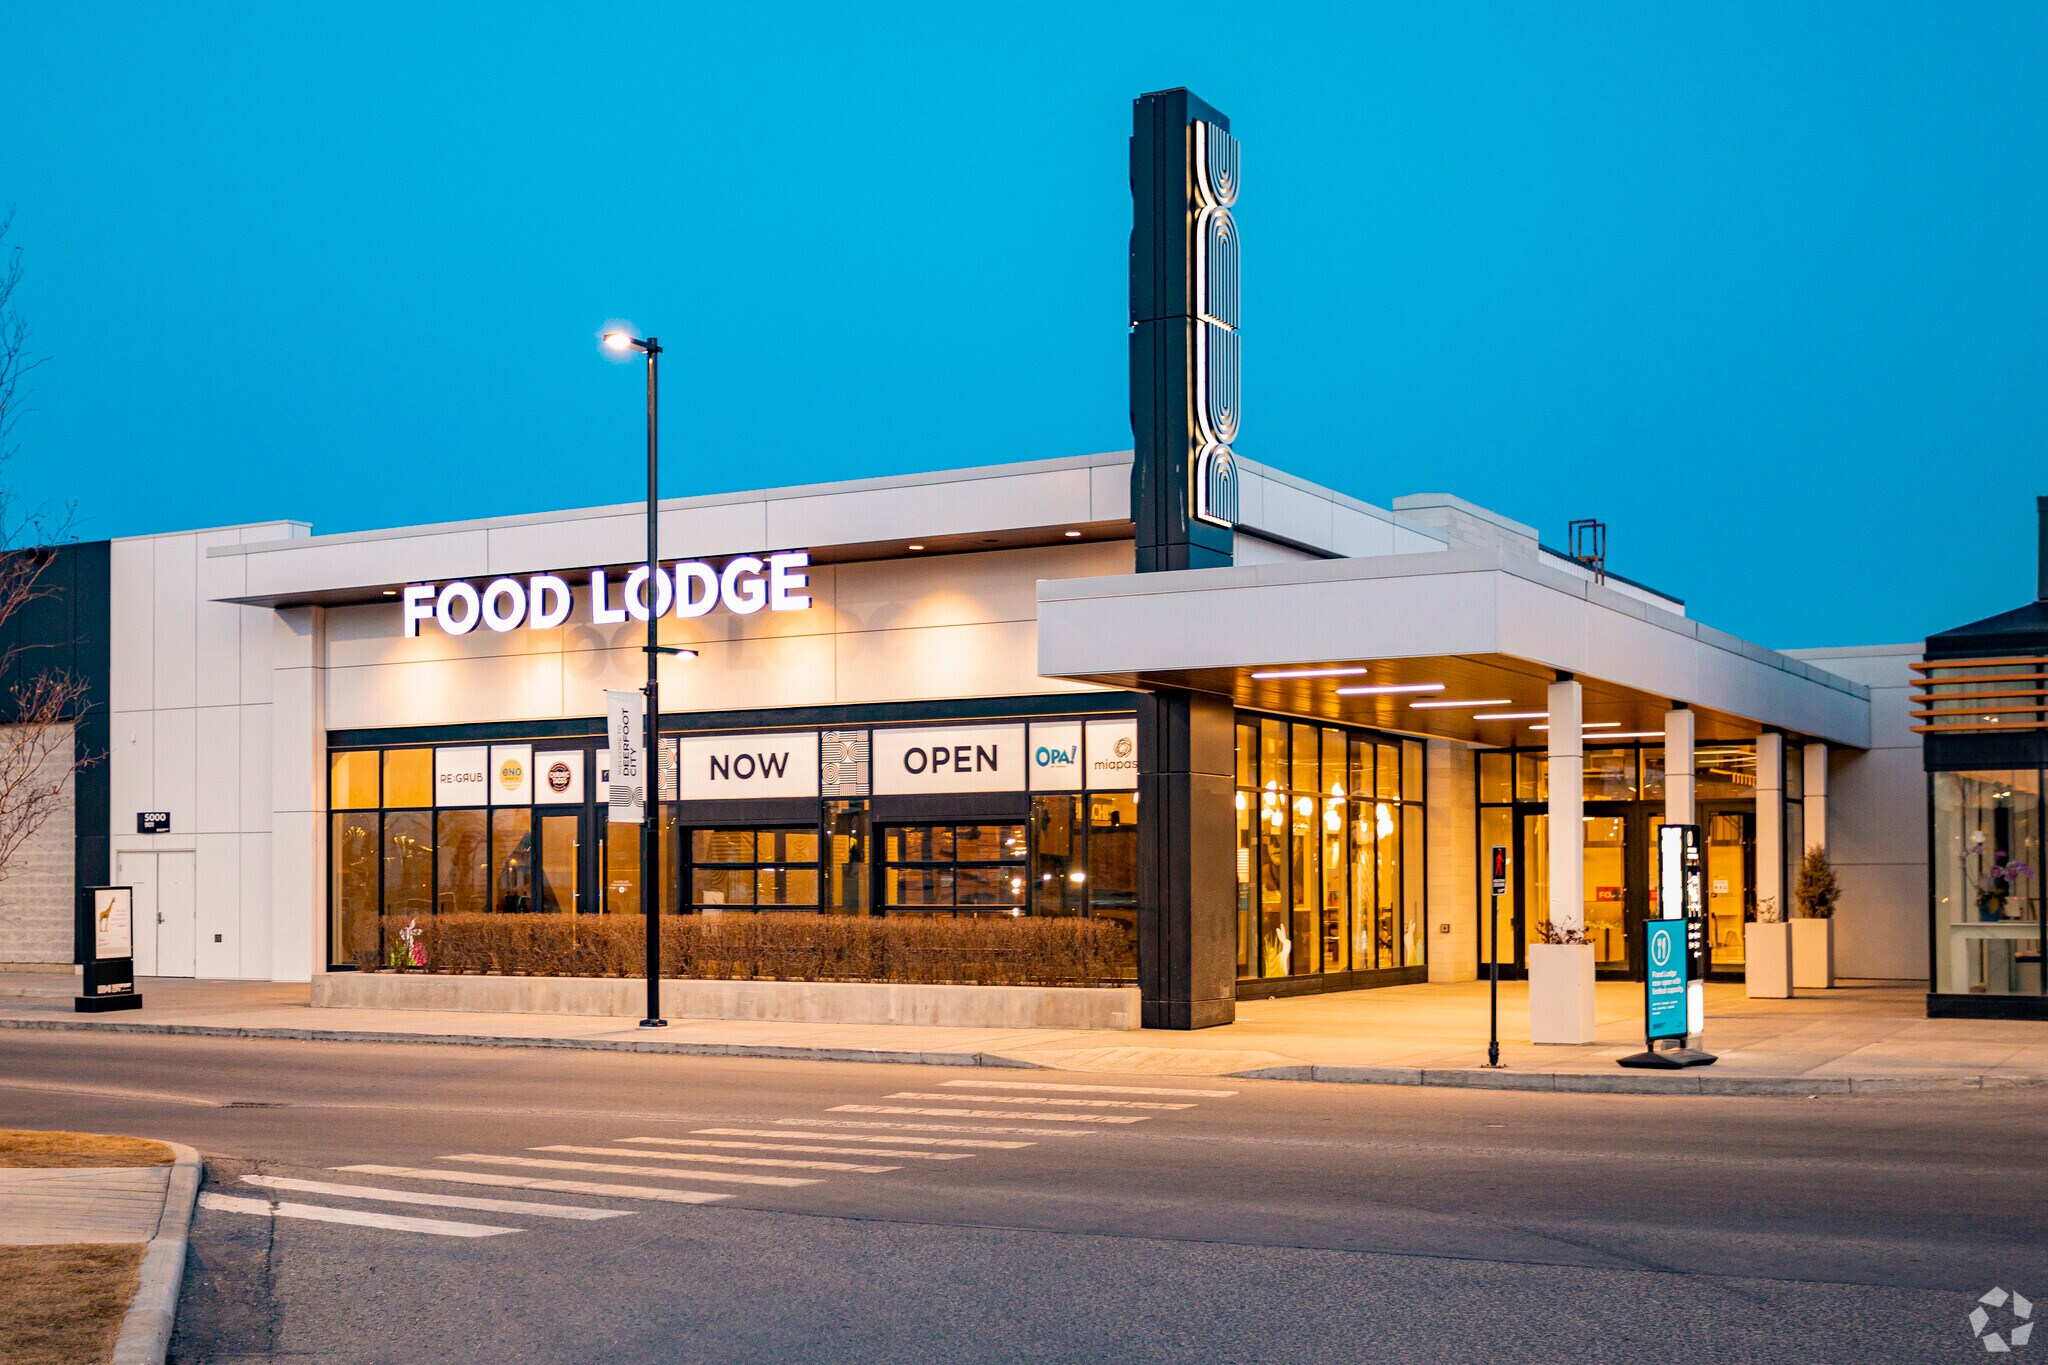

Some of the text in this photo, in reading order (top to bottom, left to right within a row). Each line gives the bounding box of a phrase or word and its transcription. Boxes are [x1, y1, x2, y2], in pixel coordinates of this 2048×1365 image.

[402, 552, 812, 639] FOOD LODGE
[622, 707, 630, 777] DEERFOOT
[1035, 745, 1077, 767] OPA!
[630, 747, 638, 777] CITY
[709, 752, 790, 781] NOW
[903, 744, 998, 775] OPEN
[144, 813, 167, 822] 5000
